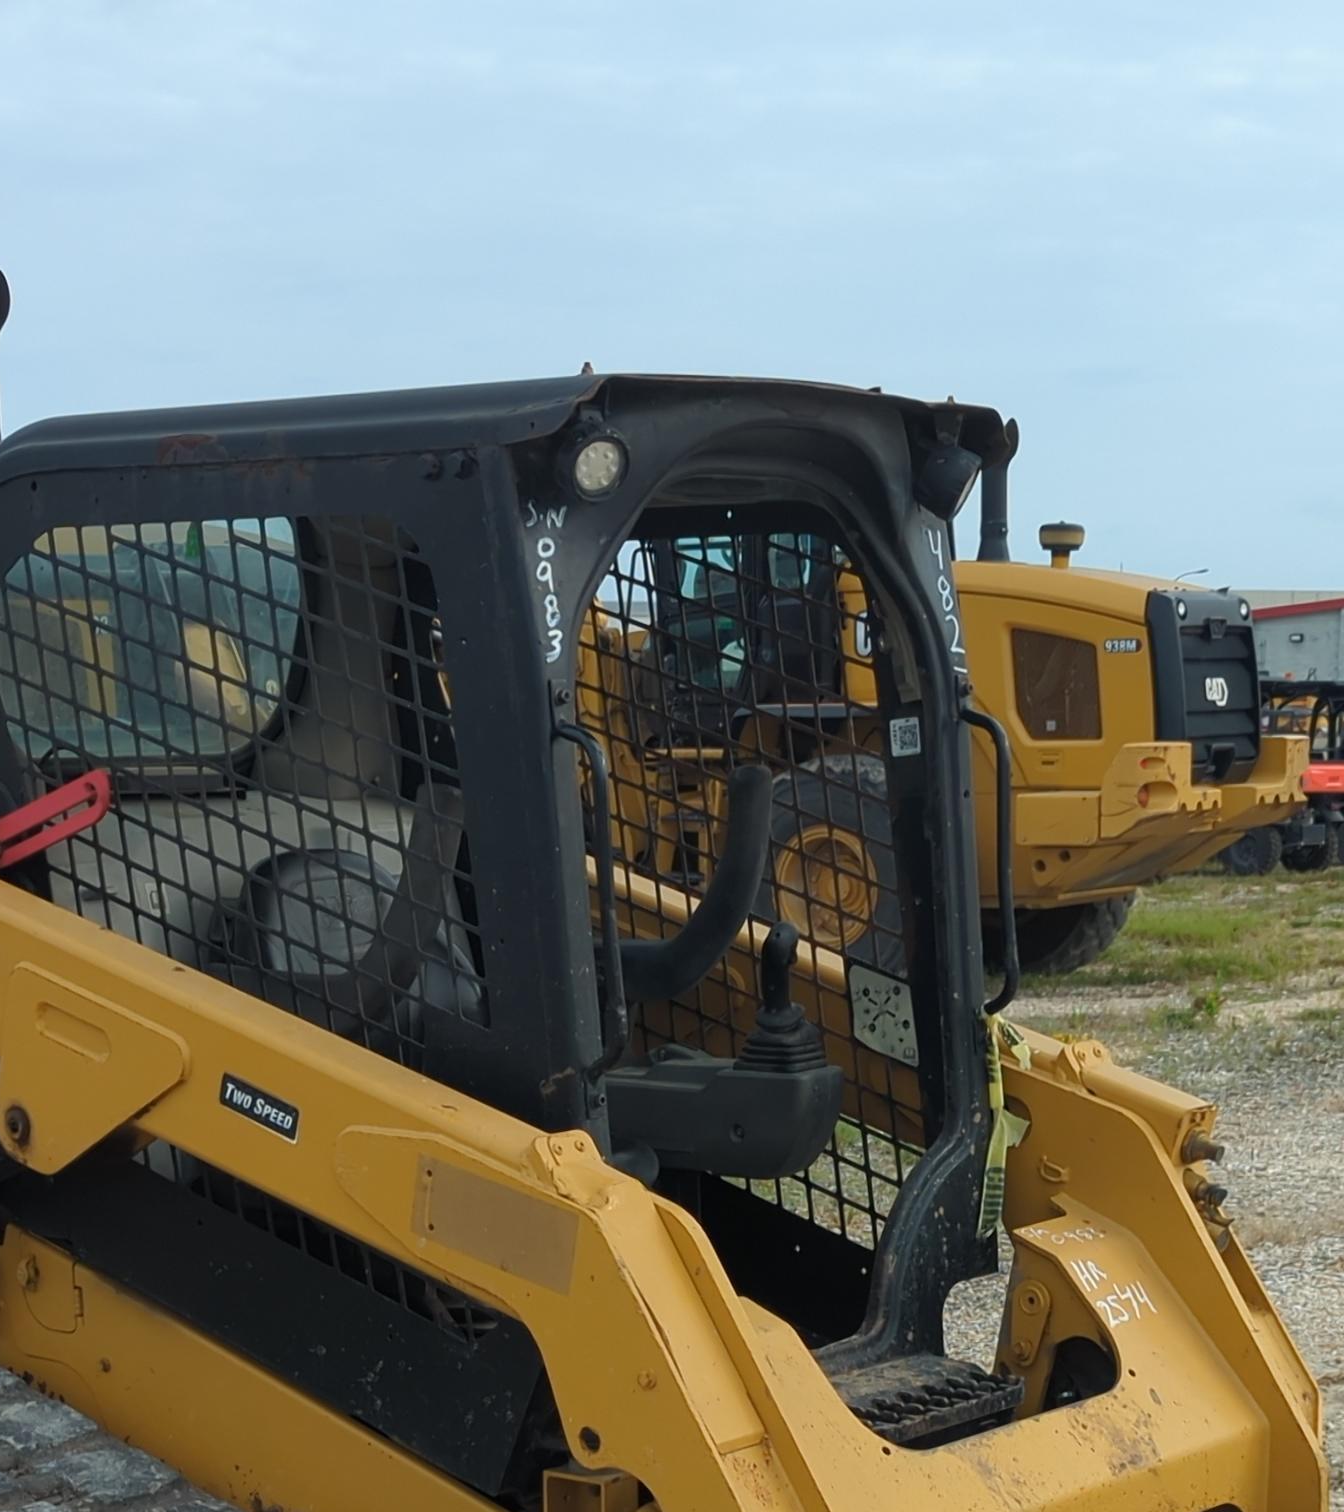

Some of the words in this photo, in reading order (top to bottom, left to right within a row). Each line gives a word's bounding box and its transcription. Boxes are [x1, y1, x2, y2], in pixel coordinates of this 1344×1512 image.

[1105, 639, 1137, 652] 938M
[1070, 1259, 1108, 1292] HR
[1096, 1280, 1158, 1329] 2544
